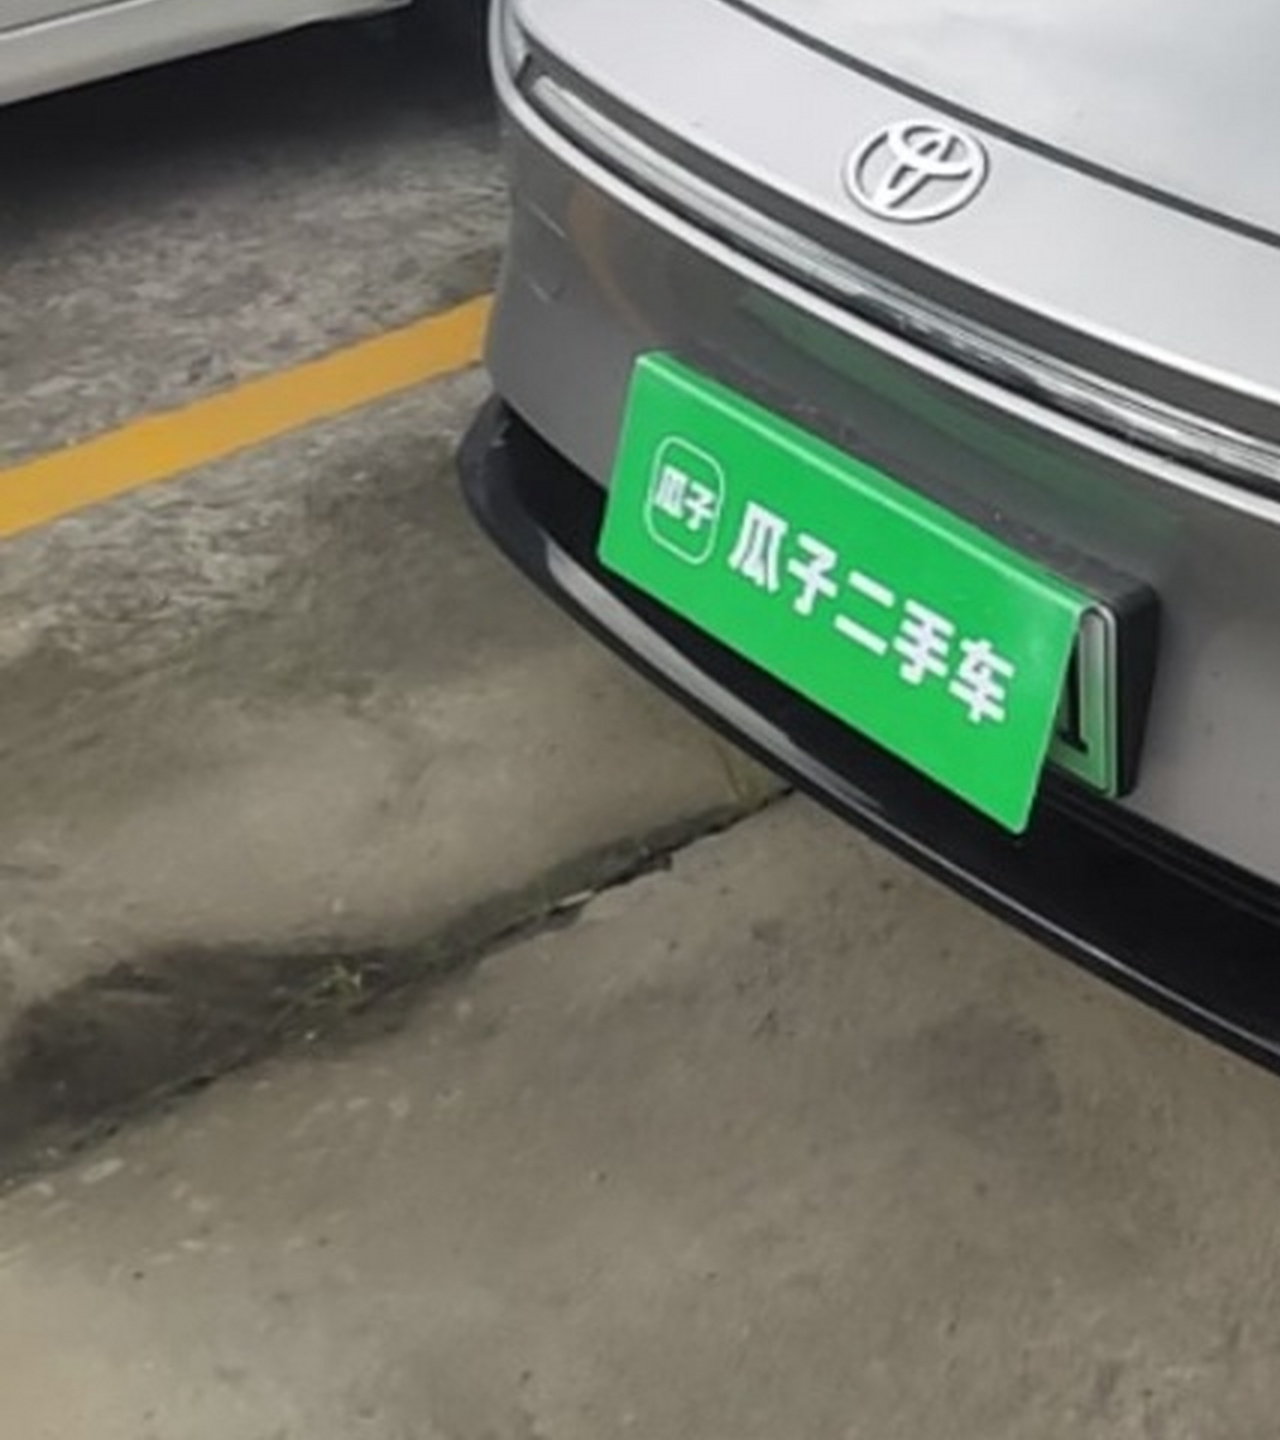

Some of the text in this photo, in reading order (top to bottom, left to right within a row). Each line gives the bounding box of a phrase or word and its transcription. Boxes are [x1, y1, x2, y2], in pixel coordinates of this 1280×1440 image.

[653, 465, 717, 532] 瓜子
[728, 500, 1015, 724] 瓜子二手车
